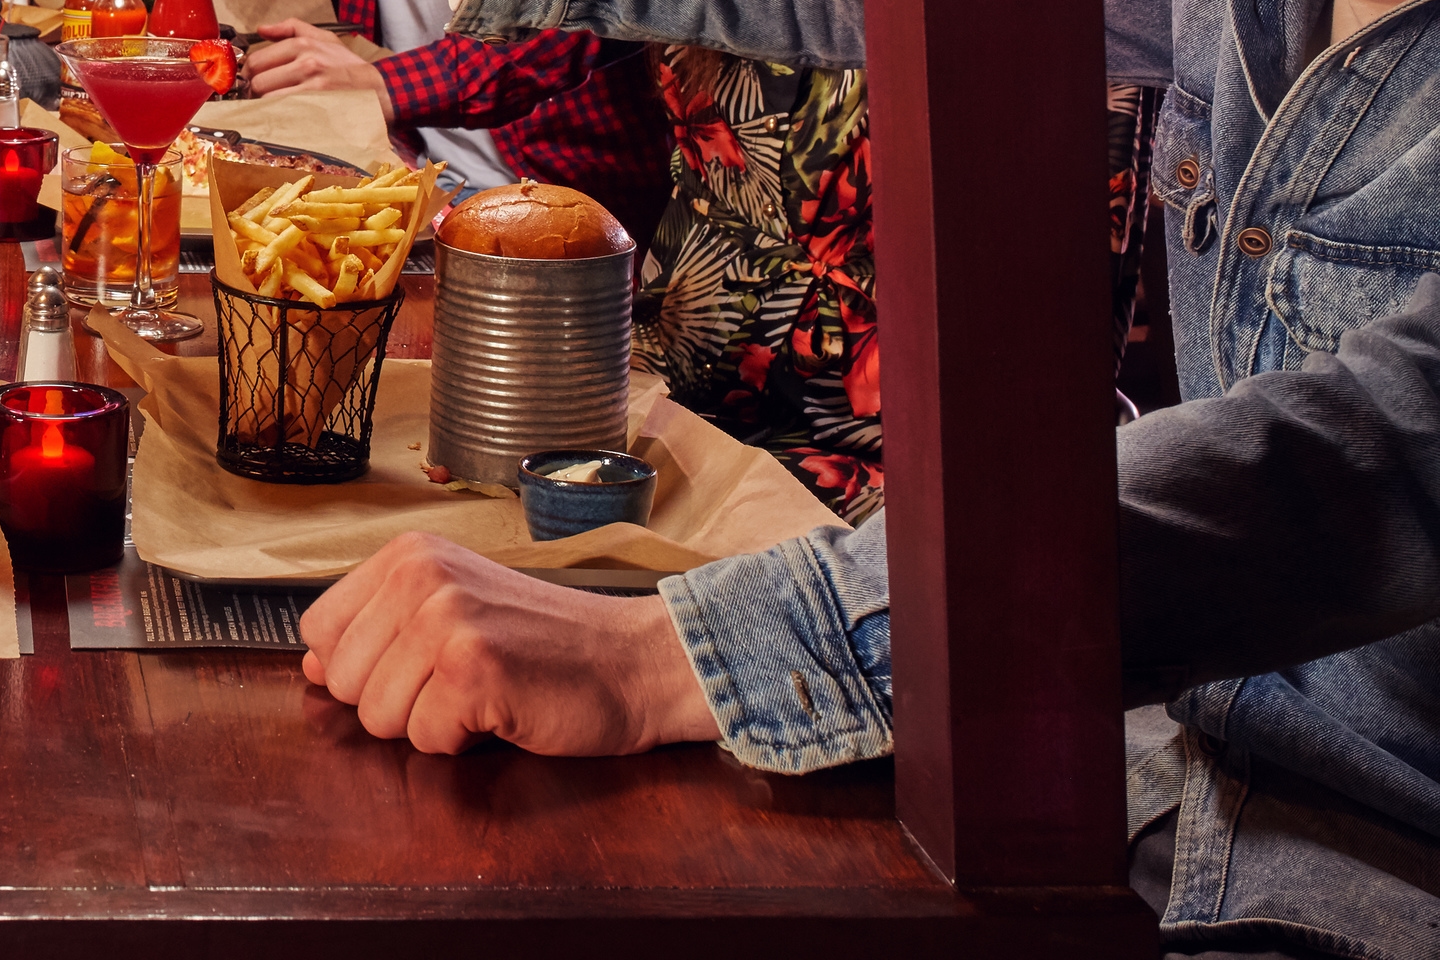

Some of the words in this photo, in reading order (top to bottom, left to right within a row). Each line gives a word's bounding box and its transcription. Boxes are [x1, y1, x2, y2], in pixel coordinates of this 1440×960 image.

[140, 597, 151, 616] BREAKFAST
[143, 616, 154, 633] ENGLISH
[283, 622, 297, 644] BREAKFAST
[146, 632, 155, 642] FULL
